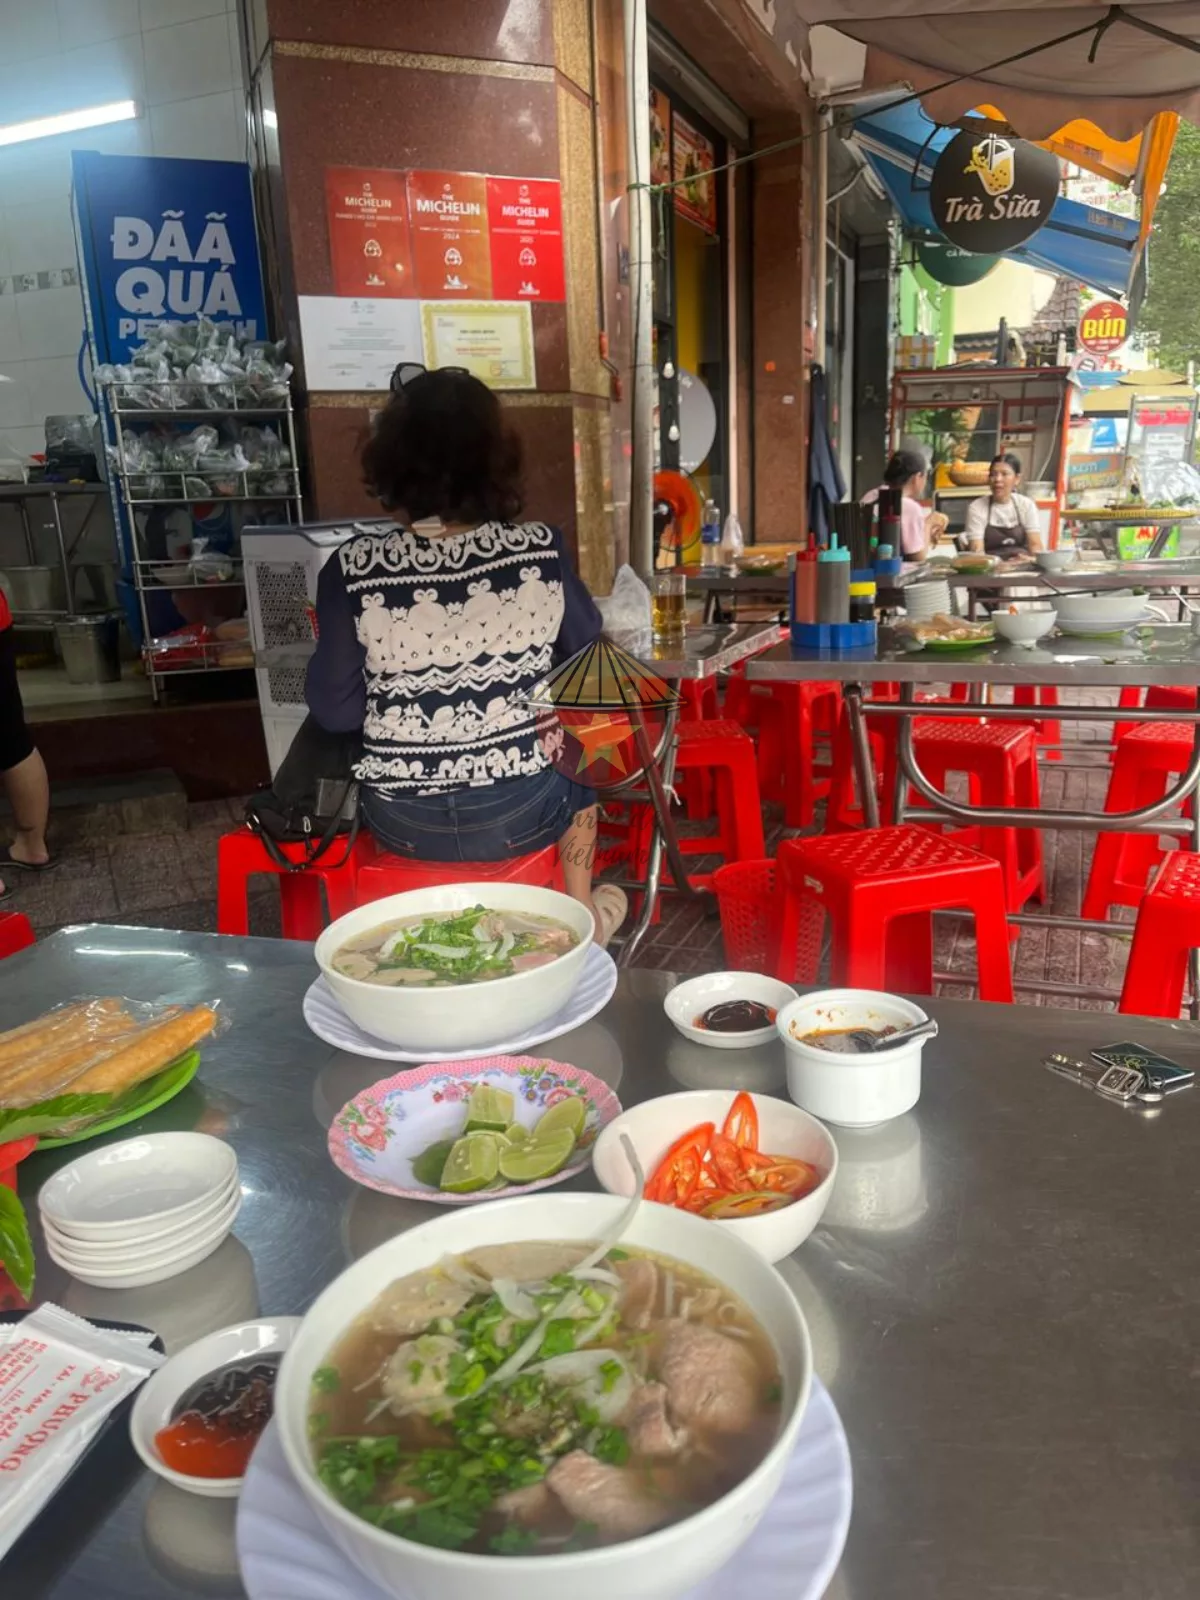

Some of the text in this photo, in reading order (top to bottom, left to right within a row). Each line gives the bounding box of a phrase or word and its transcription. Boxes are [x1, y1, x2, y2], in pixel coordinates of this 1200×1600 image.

[344, 196, 392, 208] MICHELIN
[416, 198, 481, 215] MICHELIN
[945, 193, 1040, 223] Trà Sữa
[502, 205, 549, 218] MICHELIN
[115, 265, 242, 317] QUÁ
